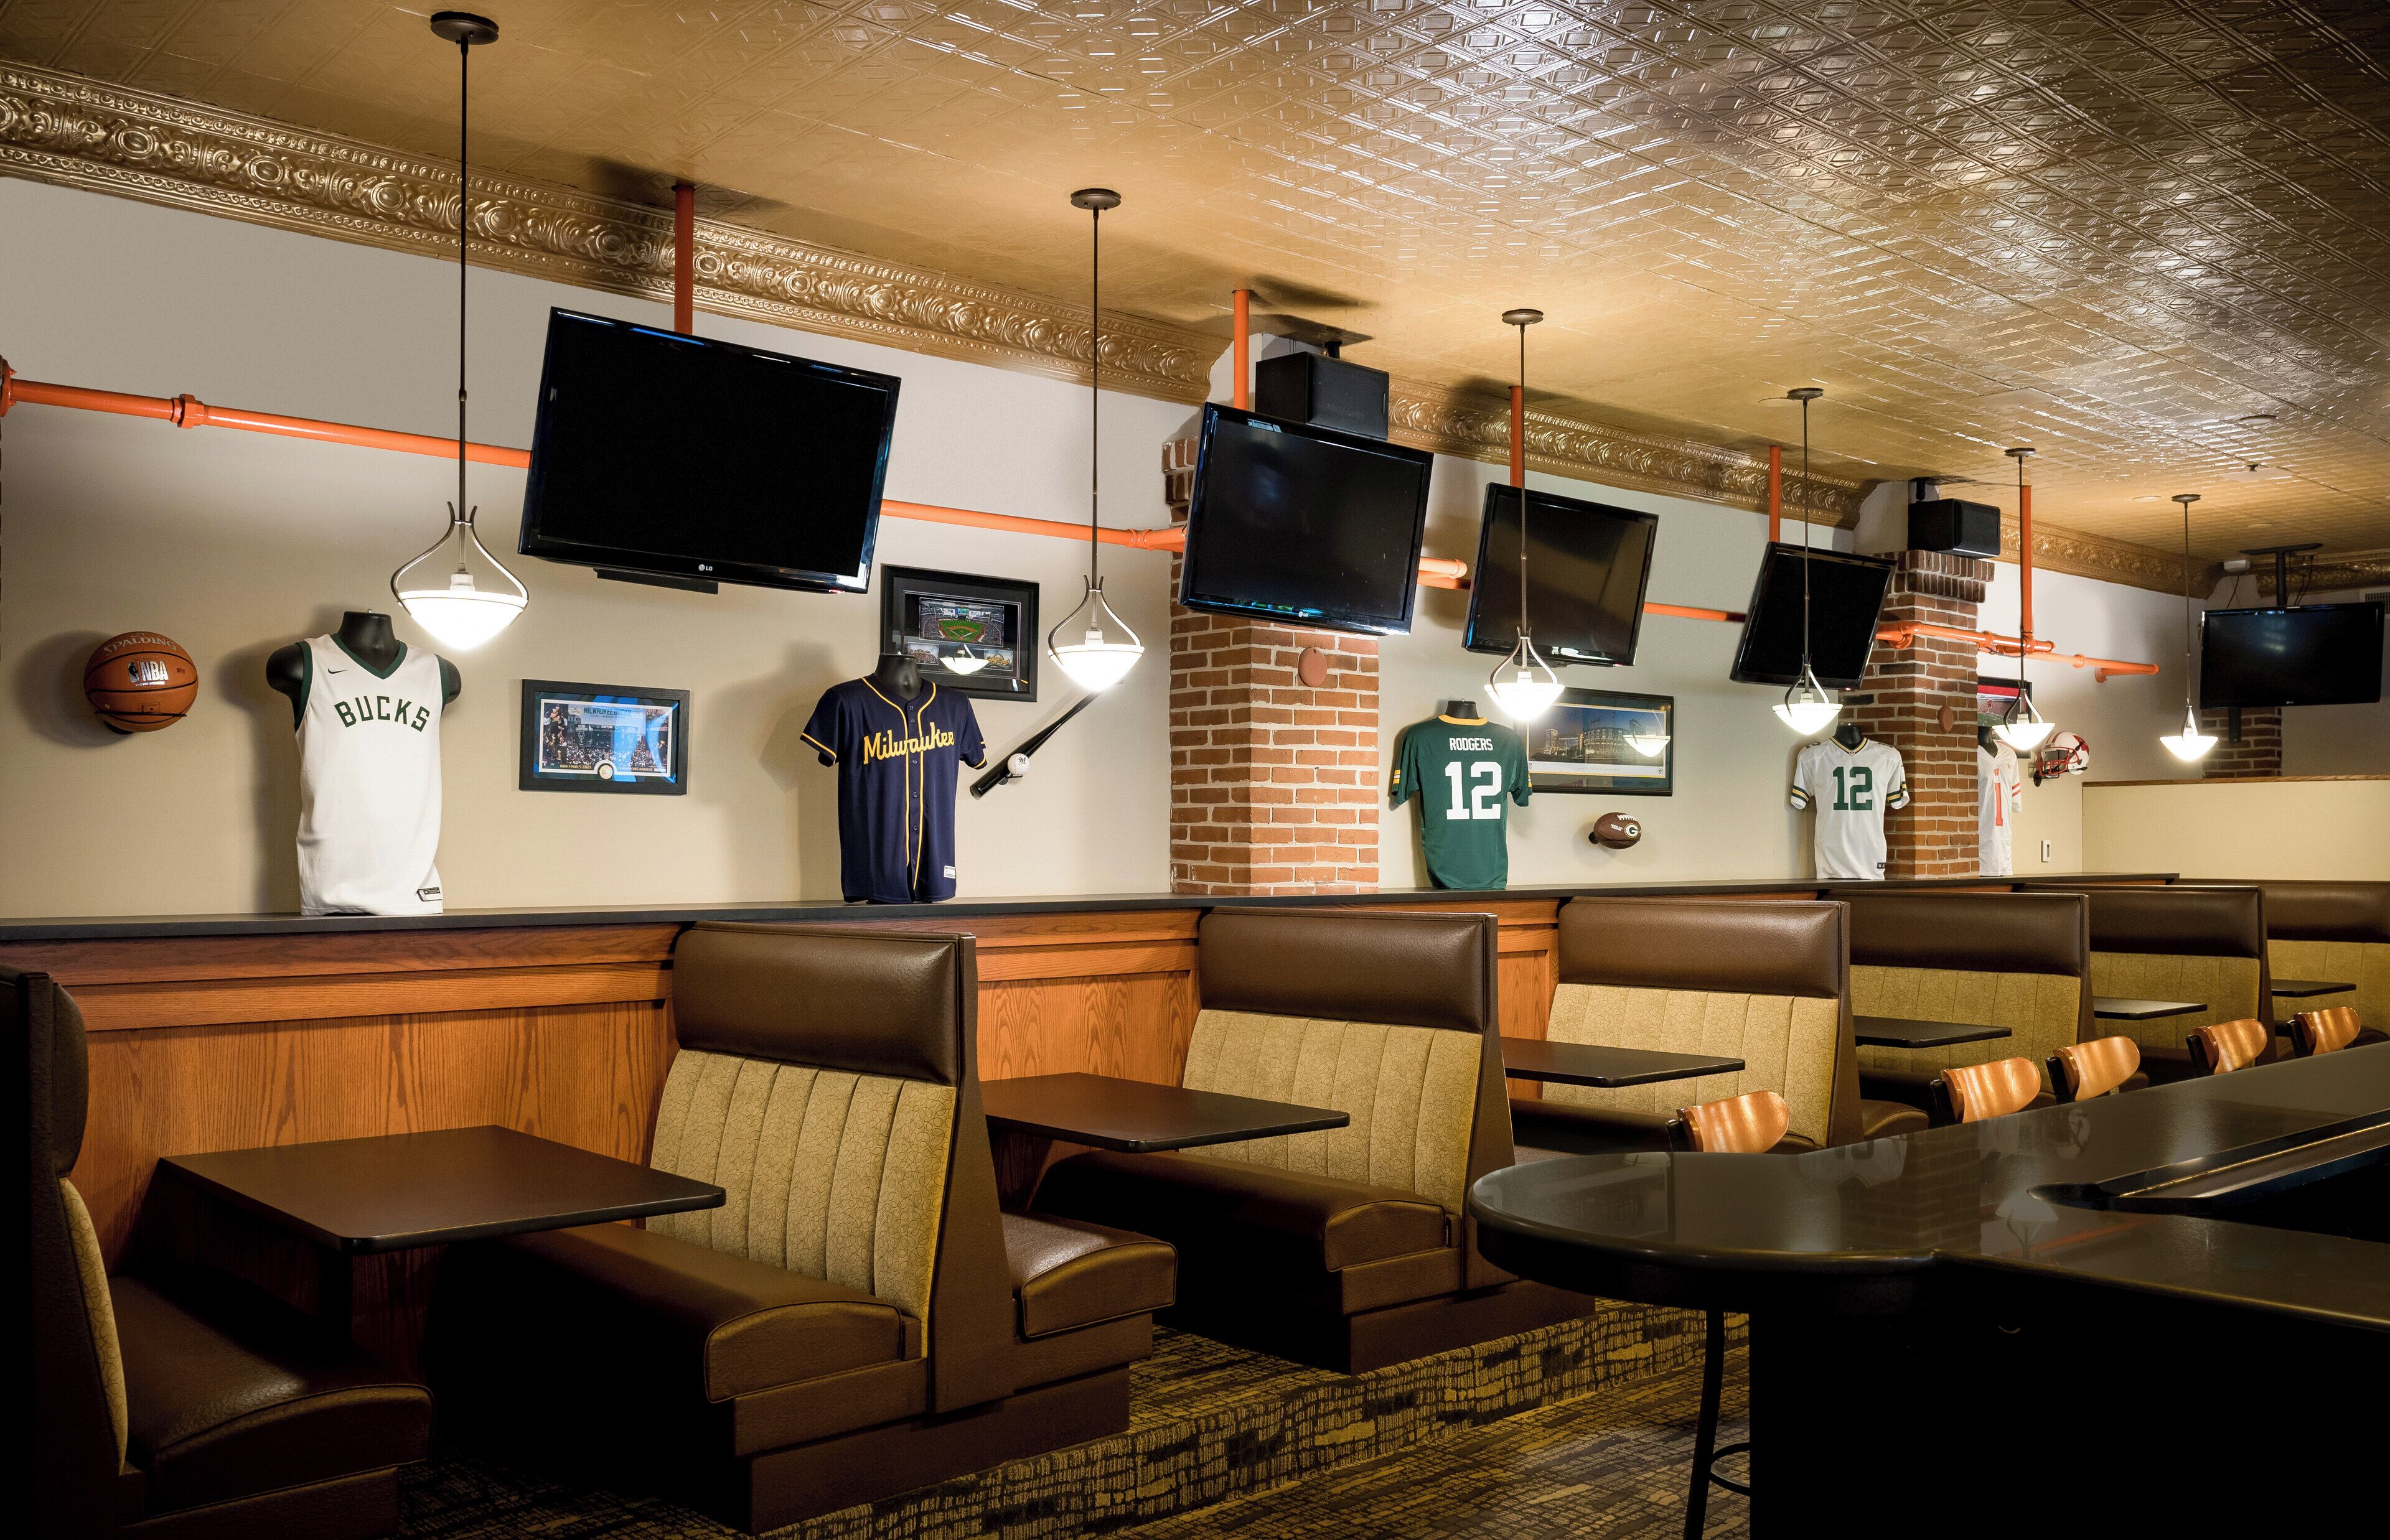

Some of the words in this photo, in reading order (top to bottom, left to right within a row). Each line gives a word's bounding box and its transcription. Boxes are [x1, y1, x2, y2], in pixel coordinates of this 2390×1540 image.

[103, 637, 179, 657] SPALDING
[139, 660, 169, 681] NBA
[334, 696, 430, 732] BUCKS
[583, 707, 613, 715] MILWAUKEE
[863, 721, 955, 765] Milwaukee
[1449, 737, 1494, 751] RODGERS
[1445, 761, 1502, 820] 12
[1832, 766, 1873, 811] 12
